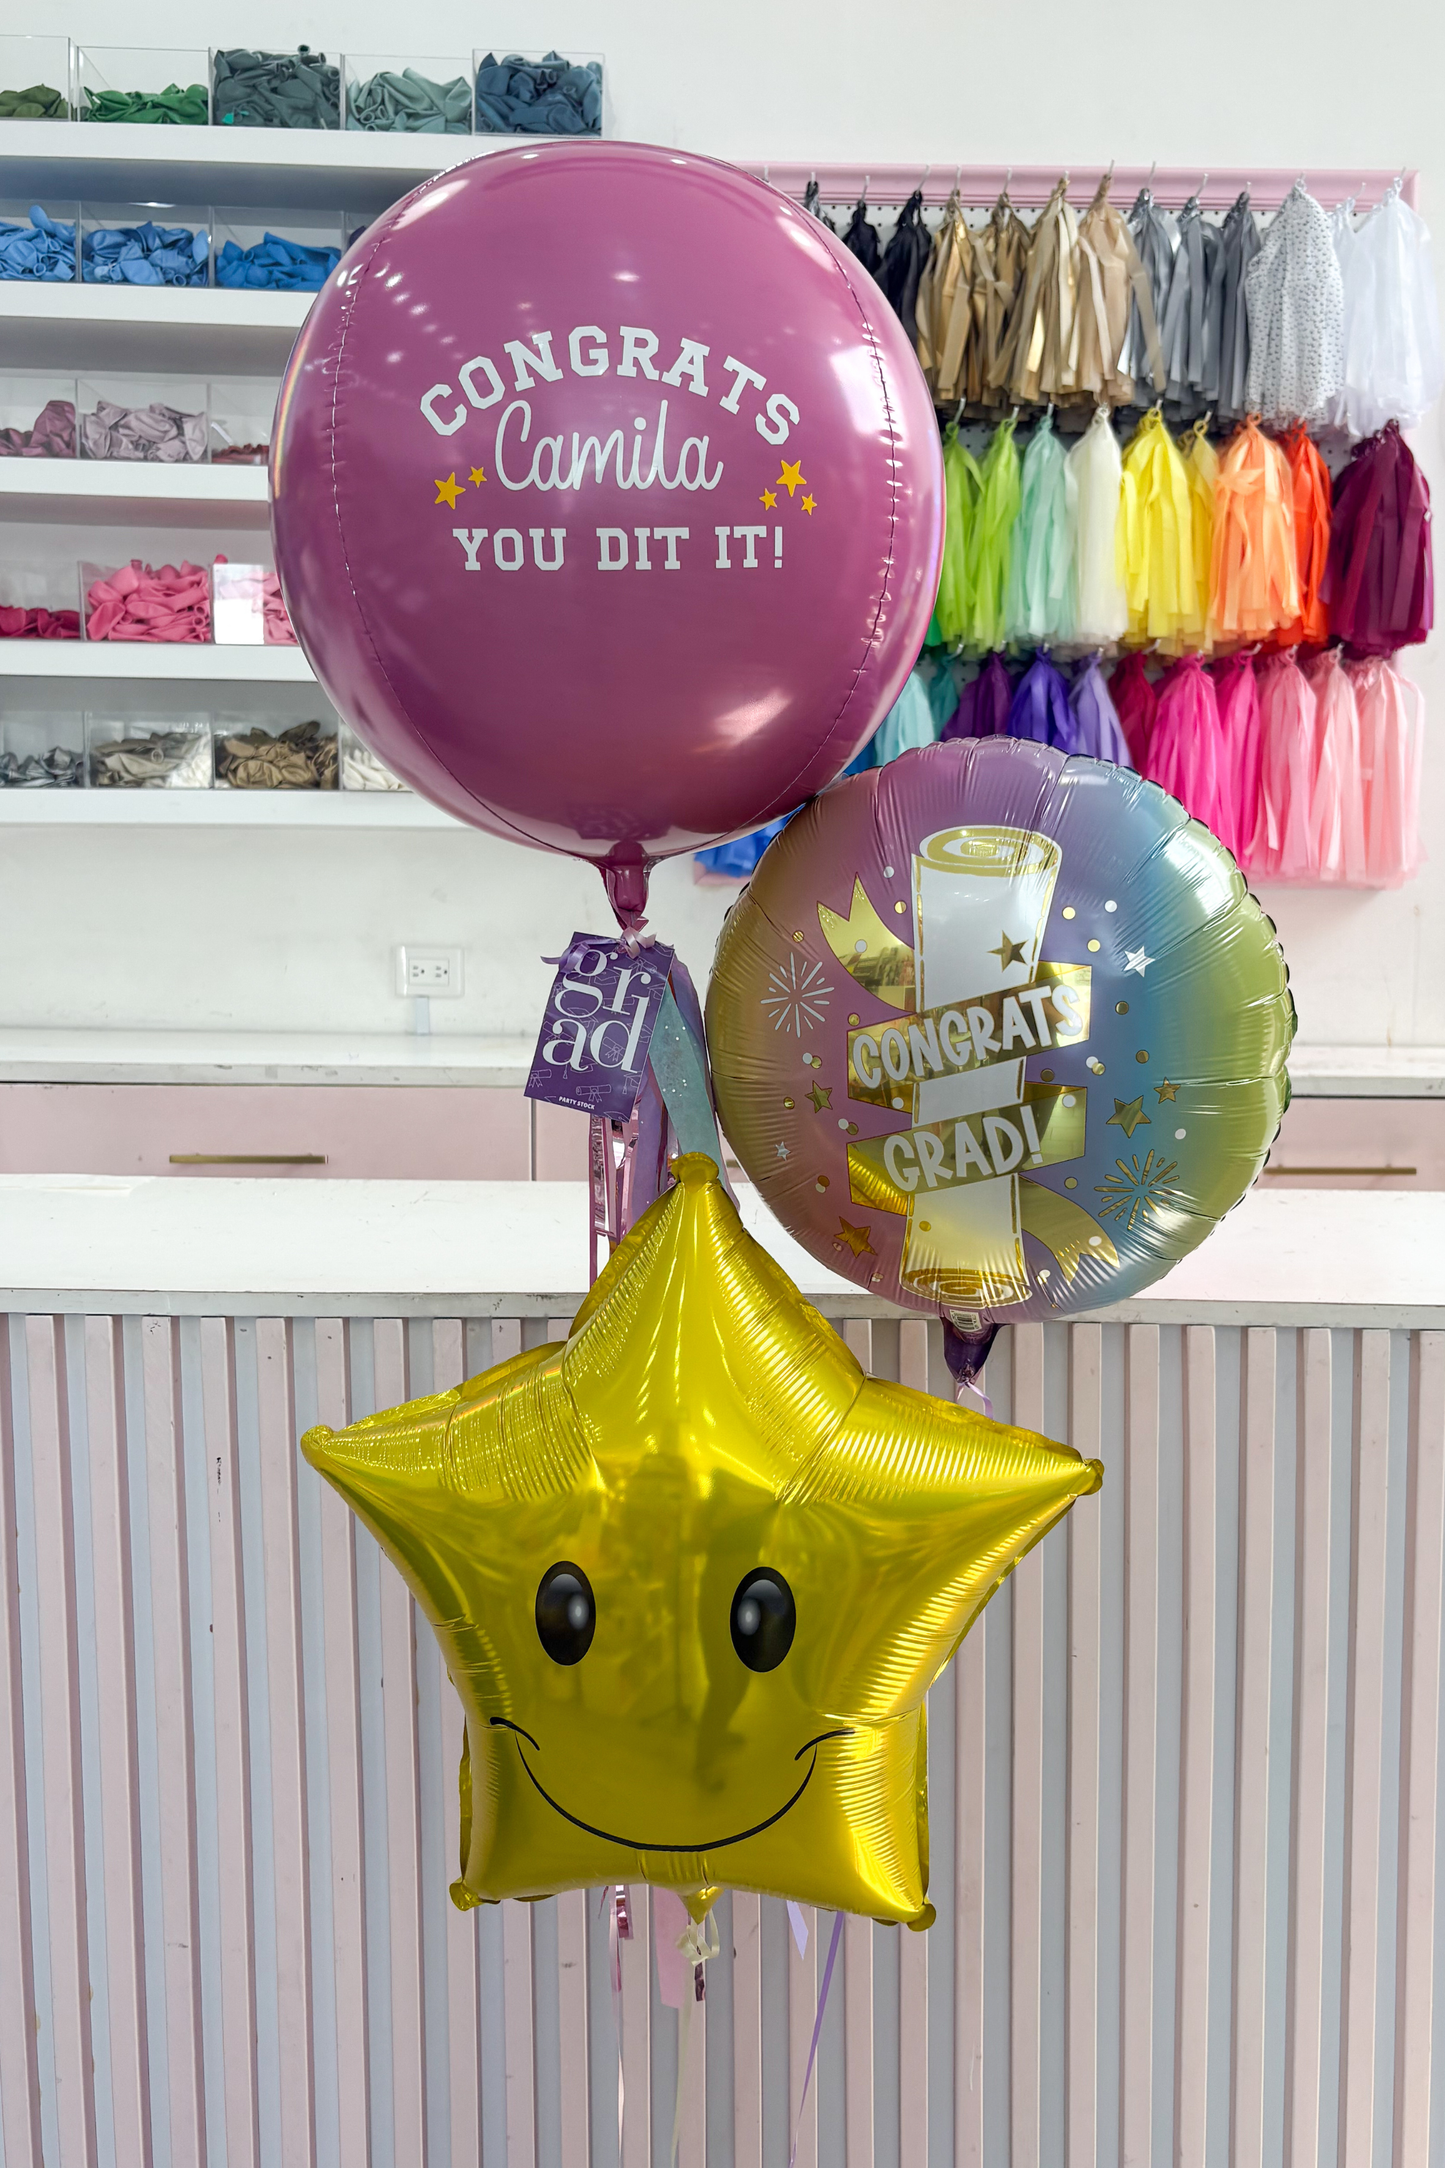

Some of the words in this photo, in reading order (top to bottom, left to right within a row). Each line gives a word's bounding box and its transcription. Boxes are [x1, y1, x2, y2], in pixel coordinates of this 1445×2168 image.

[420, 325, 800, 446] CONGRATS
[495, 399, 724, 491] Camila
[452, 528, 567, 571] YOU
[596, 527, 690, 571] DIT
[715, 526, 783, 569] IT!
[852, 984, 1082, 1089] CONGRATS
[558, 1096, 577, 1105] PARTY
[577, 1100, 596, 1110] STOCK
[883, 1105, 1045, 1192] GRAD!
